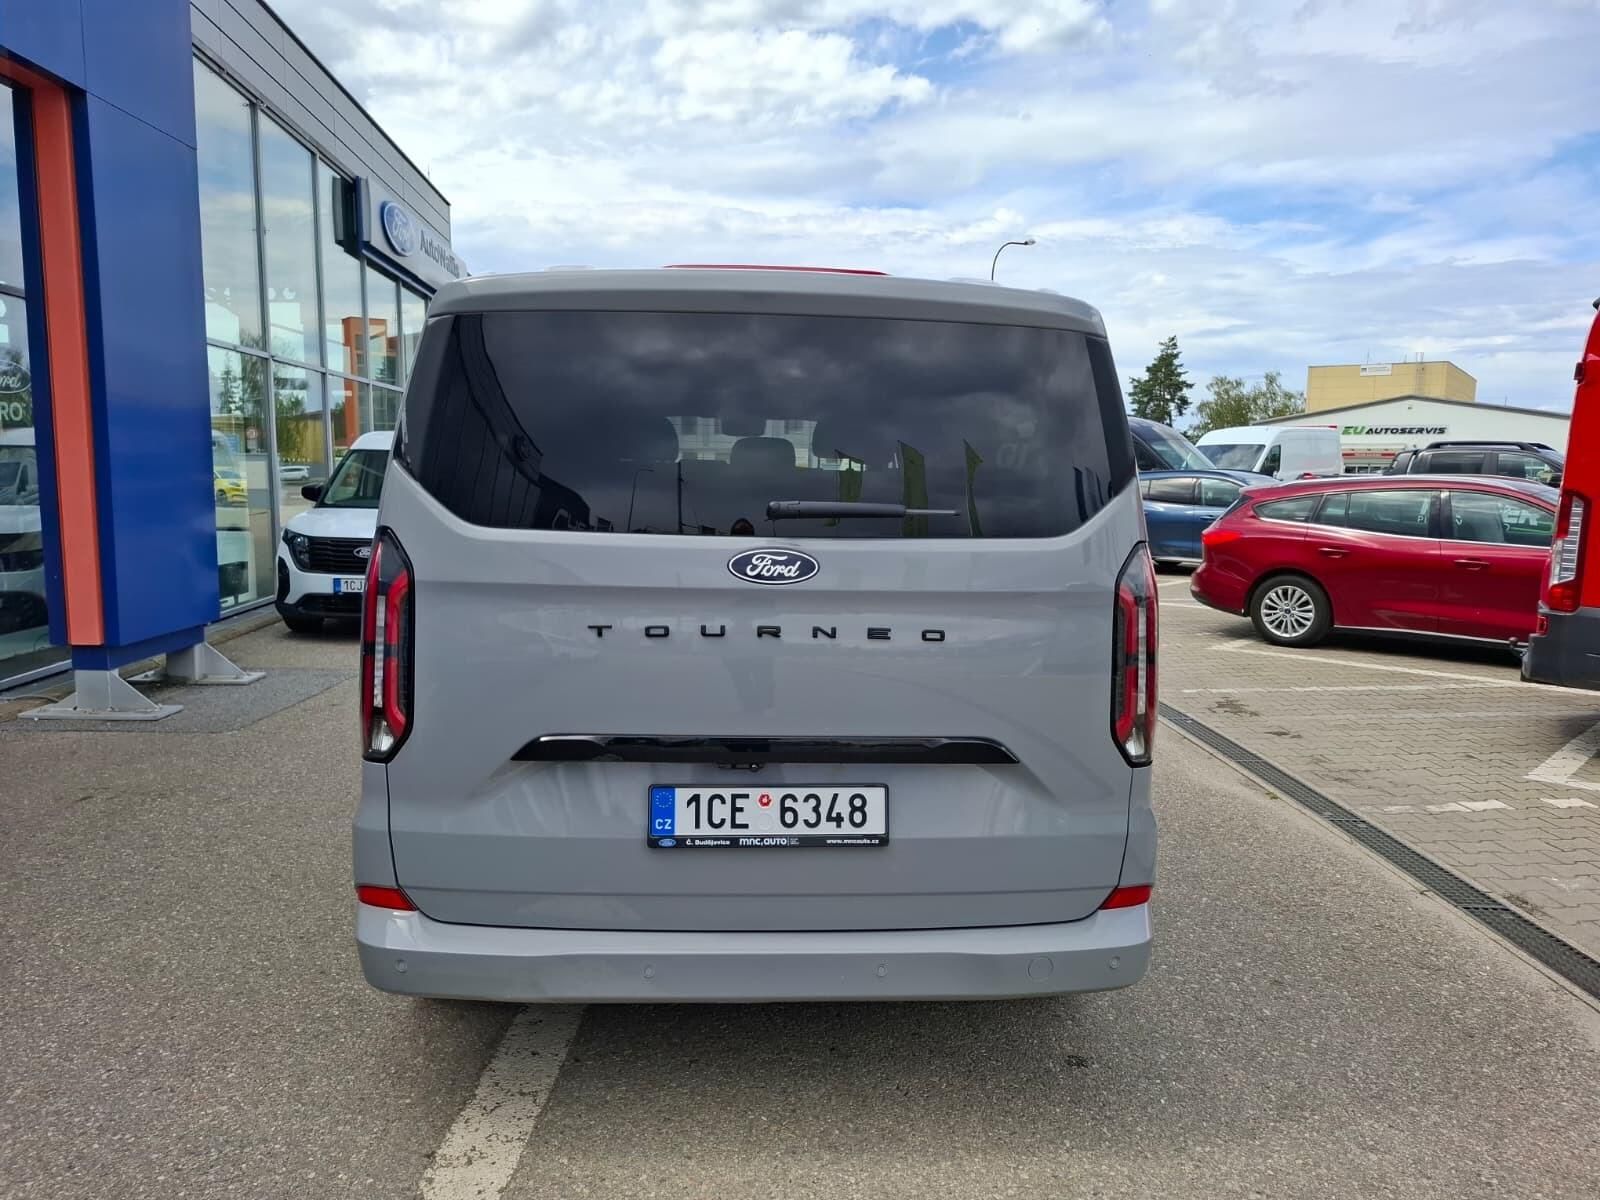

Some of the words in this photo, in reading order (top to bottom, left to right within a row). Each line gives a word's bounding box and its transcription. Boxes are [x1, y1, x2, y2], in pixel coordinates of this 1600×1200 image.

[1342, 426, 1366, 435] EU
[1366, 427, 1447, 435] AUTOSERVIS
[746, 553, 800, 577] Ford
[588, 624, 947, 642] TOURNEO
[686, 792, 750, 830] 1CE
[780, 793, 868, 829] 6348
[655, 818, 672, 830] CZ
